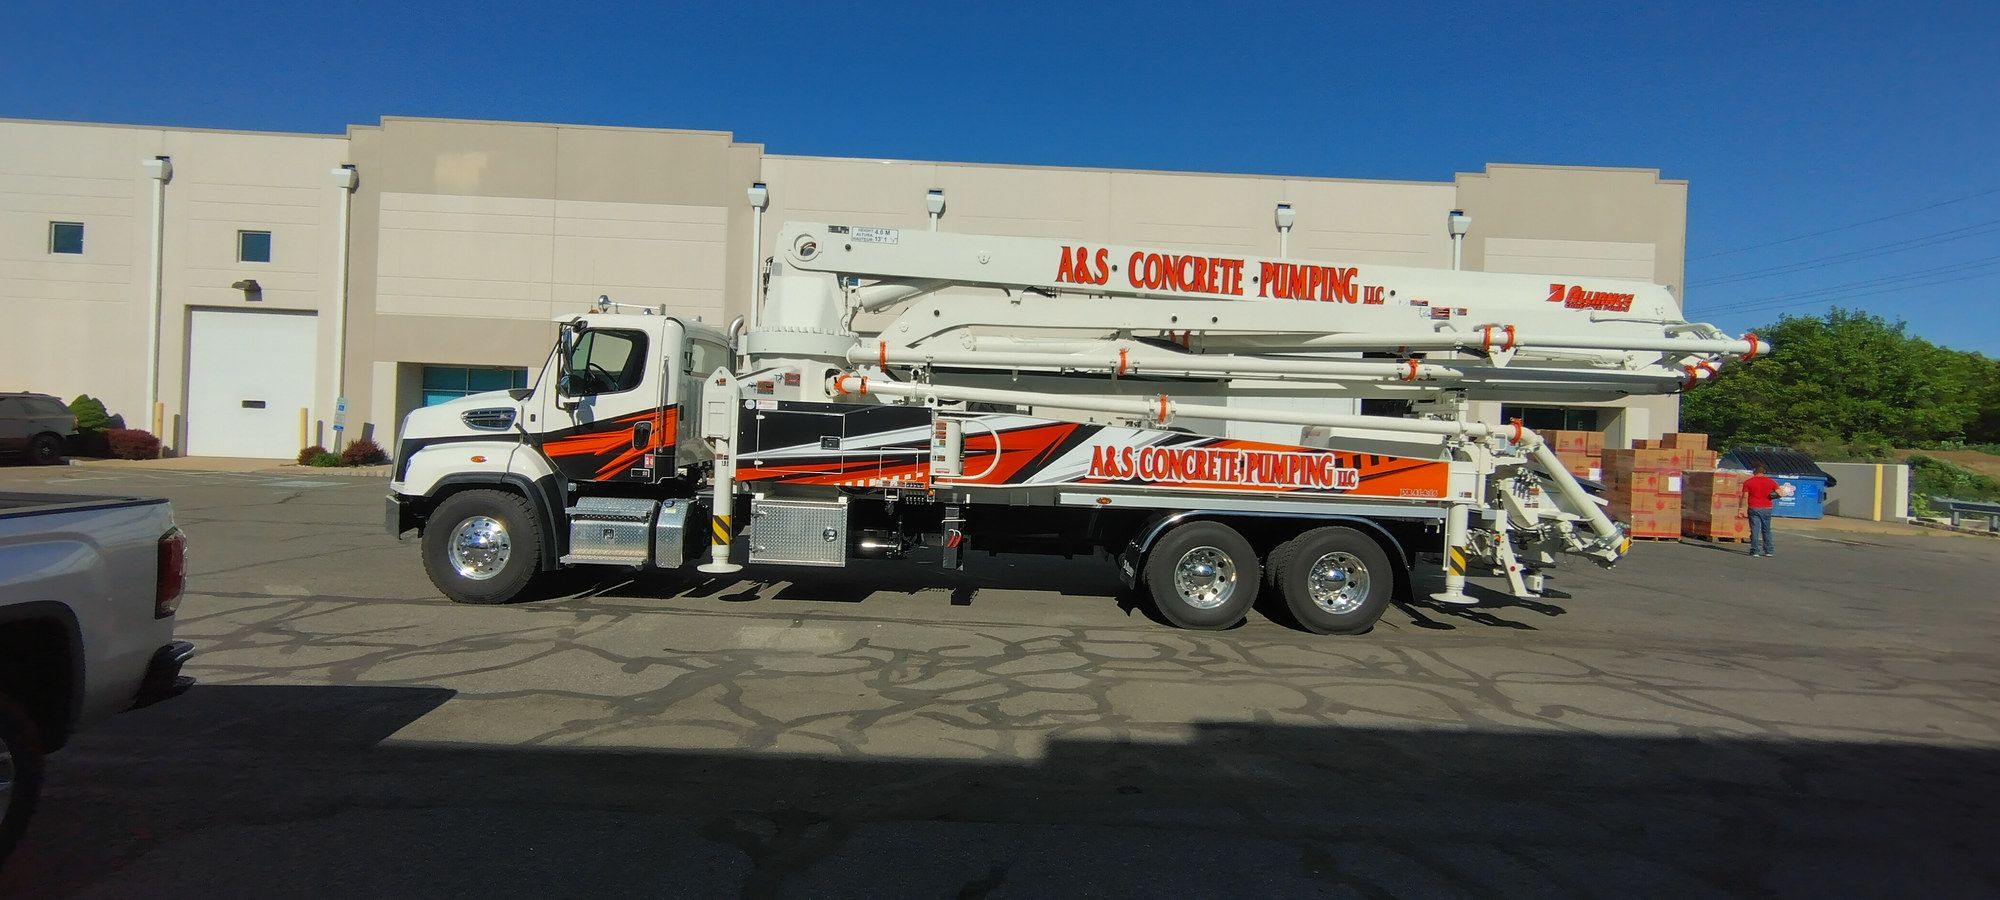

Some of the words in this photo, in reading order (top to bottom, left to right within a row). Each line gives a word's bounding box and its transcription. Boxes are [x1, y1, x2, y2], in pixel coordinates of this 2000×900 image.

[1055, 246, 1109, 285] A&S
[1128, 251, 1245, 296] CONCRETE
[1257, 261, 1358, 304] PUMPING
[1363, 286, 1385, 305] LLC
[1089, 445, 1134, 478] A&S
[1140, 447, 1239, 482] CONCRETE
[1246, 452, 1334, 487] PUMPING
[1337, 470, 1356, 487] LLC
